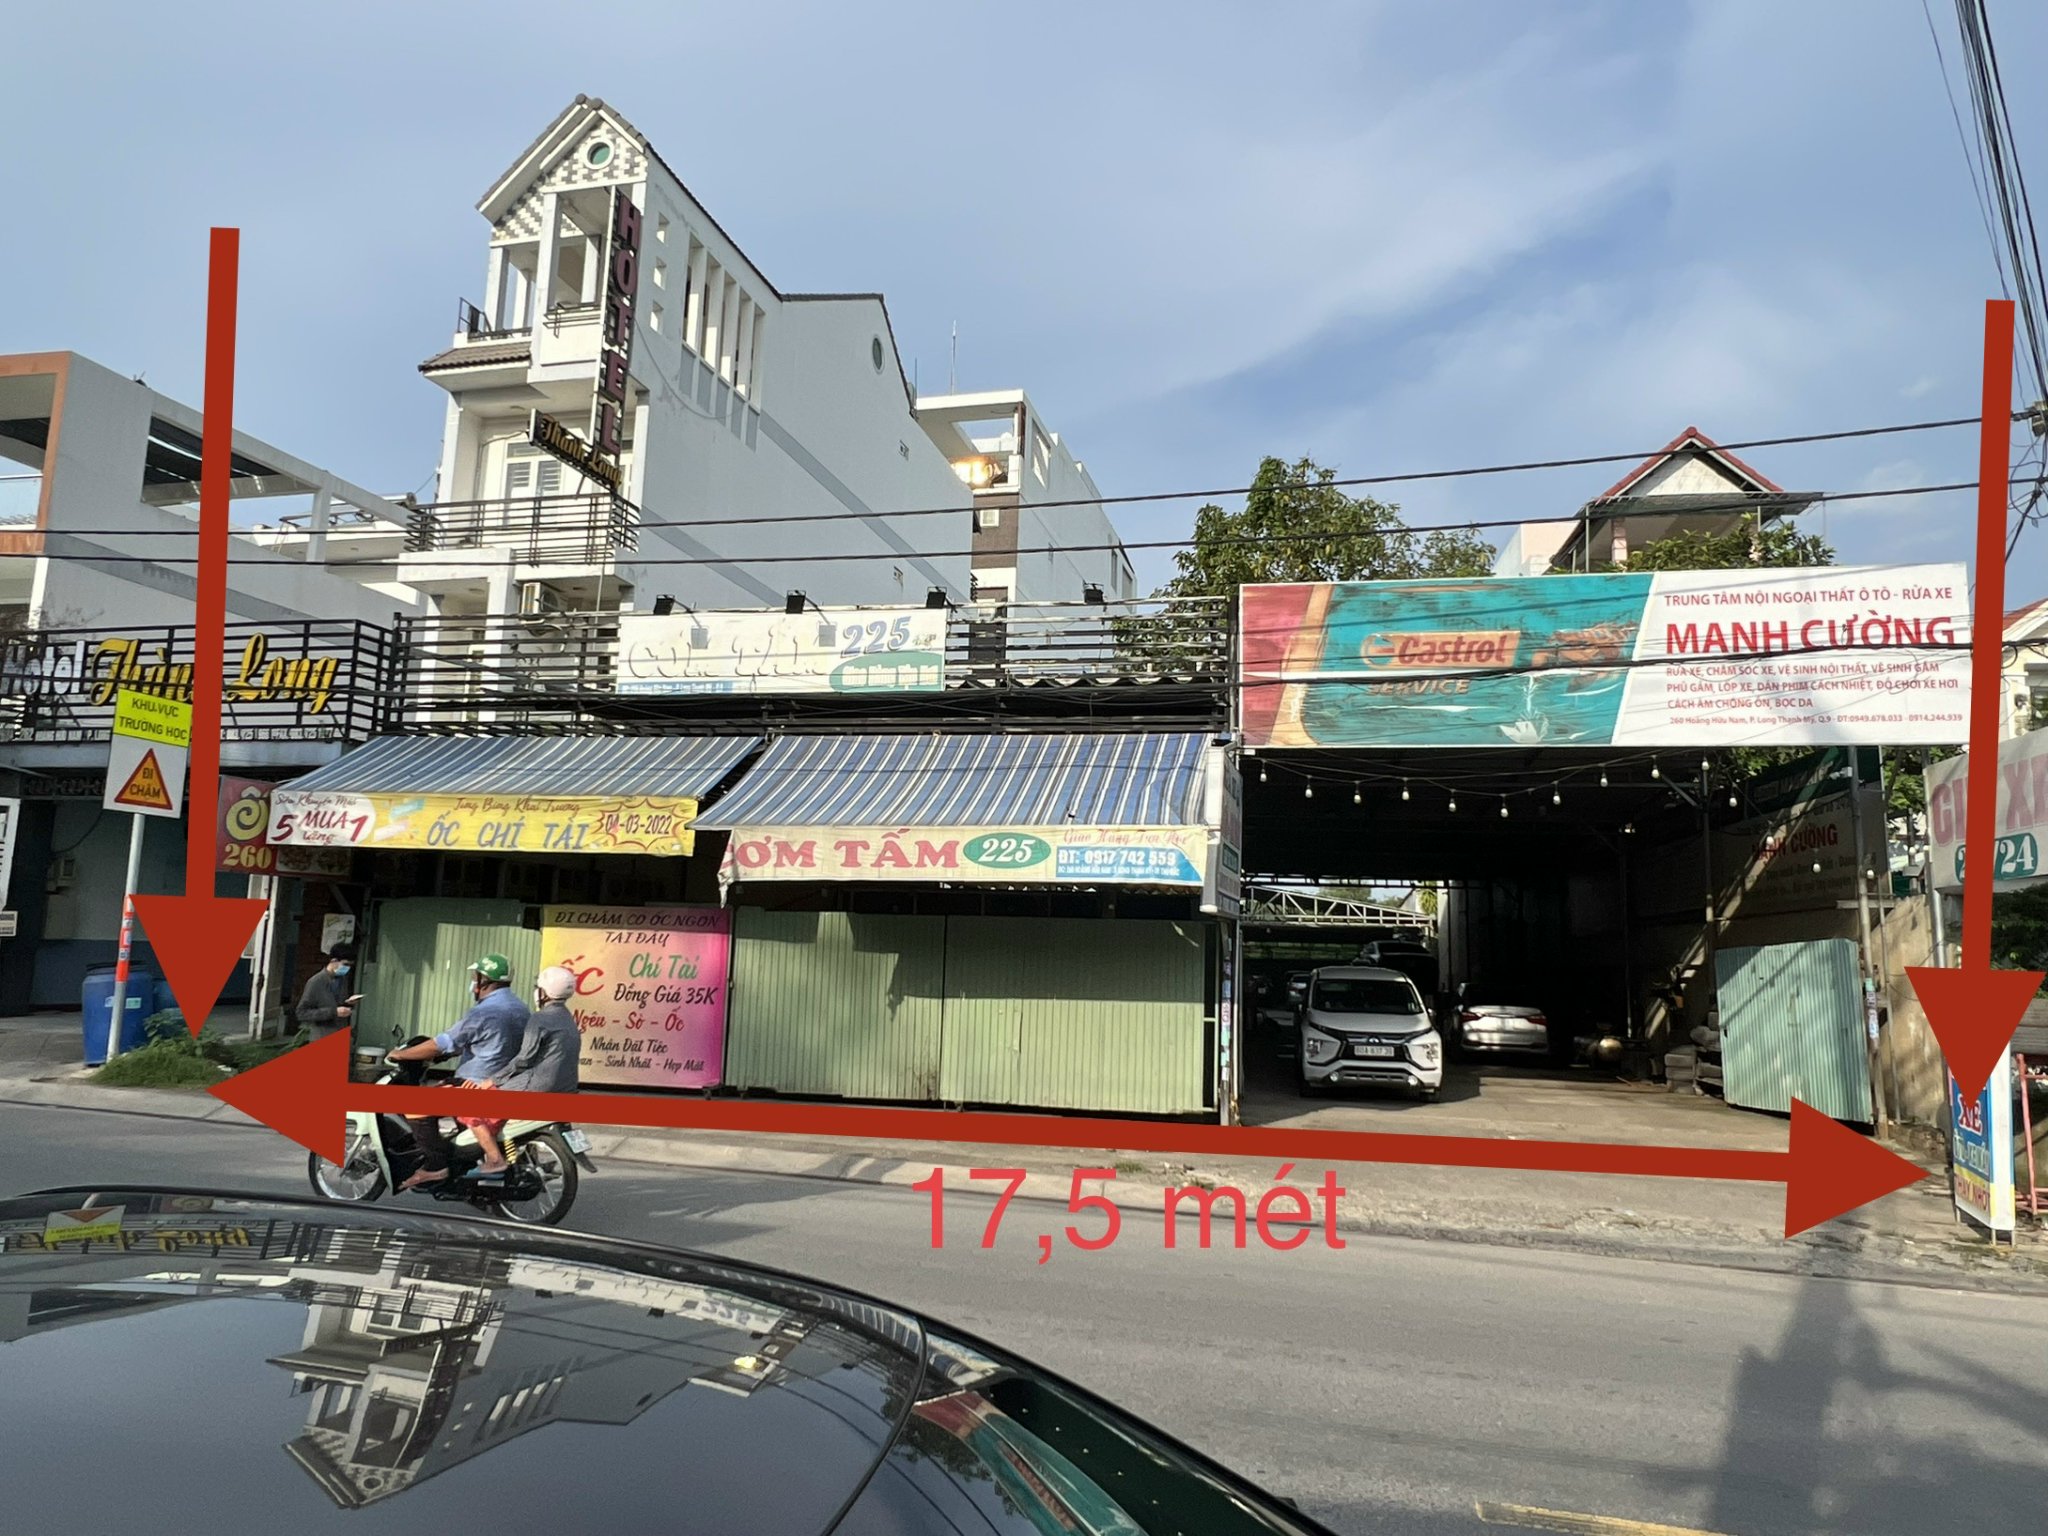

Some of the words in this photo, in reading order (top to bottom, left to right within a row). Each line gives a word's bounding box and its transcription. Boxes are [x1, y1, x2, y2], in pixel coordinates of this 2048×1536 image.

[602, 197, 641, 454] HOTEL
[1664, 594, 1710, 606] TRUNG
[1713, 590, 1740, 605] TÂM
[1745, 590, 1769, 607] NỘI
[1773, 590, 1817, 605] NGOẠI
[1820, 585, 1855, 601] THẤT
[1859, 588, 1870, 601] Ô
[1873, 586, 1891, 600] TÔ
[1902, 584, 1932, 600] RỬA
[1935, 587, 1953, 599] XE
[841, 615, 911, 659] 225
[1801, 610, 1955, 652] CƯỜNG
[1399, 634, 1508, 665] Castrol
[226, 633, 338, 714] Long
[1794, 665, 1817, 675] SINH
[1924, 679, 1936, 689] XE
[1798, 698, 1813, 708] DA
[143, 767, 154, 780] ĐI
[271, 814, 298, 841] 5
[300, 811, 348, 830] MUA
[349, 815, 369, 842] 1
[427, 811, 460, 847] ỐC
[477, 815, 526, 849] CHÍ
[223, 842, 272, 869] 260
[833, 828, 960, 869] TẤM
[976, 836, 1036, 863] 225
[629, 953, 662, 978] Chí
[668, 955, 701, 980] Tài
[654, 984, 683, 1005] Giá
[685, 986, 720, 1006] 35K
[605, 1055, 626, 1068] Sinh
